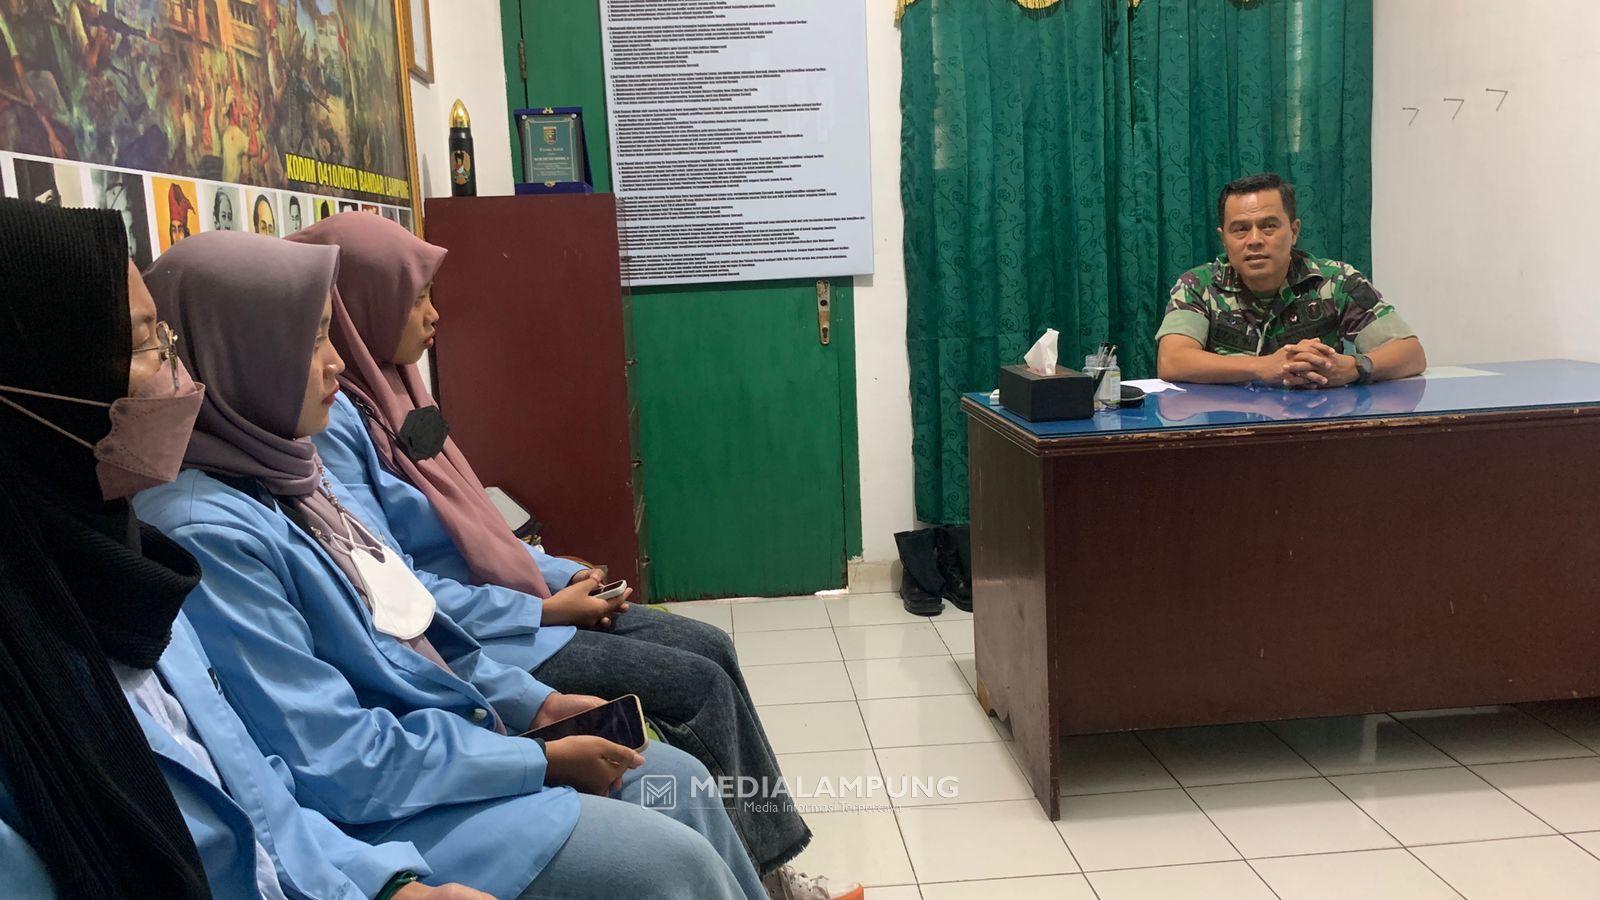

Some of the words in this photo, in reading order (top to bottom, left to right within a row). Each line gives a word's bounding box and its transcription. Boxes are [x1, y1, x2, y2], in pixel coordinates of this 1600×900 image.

[285, 153, 317, 184] KODIM
[317, 161, 359, 191] 0410/KOTA
[358, 169, 386, 195] BANDAR
